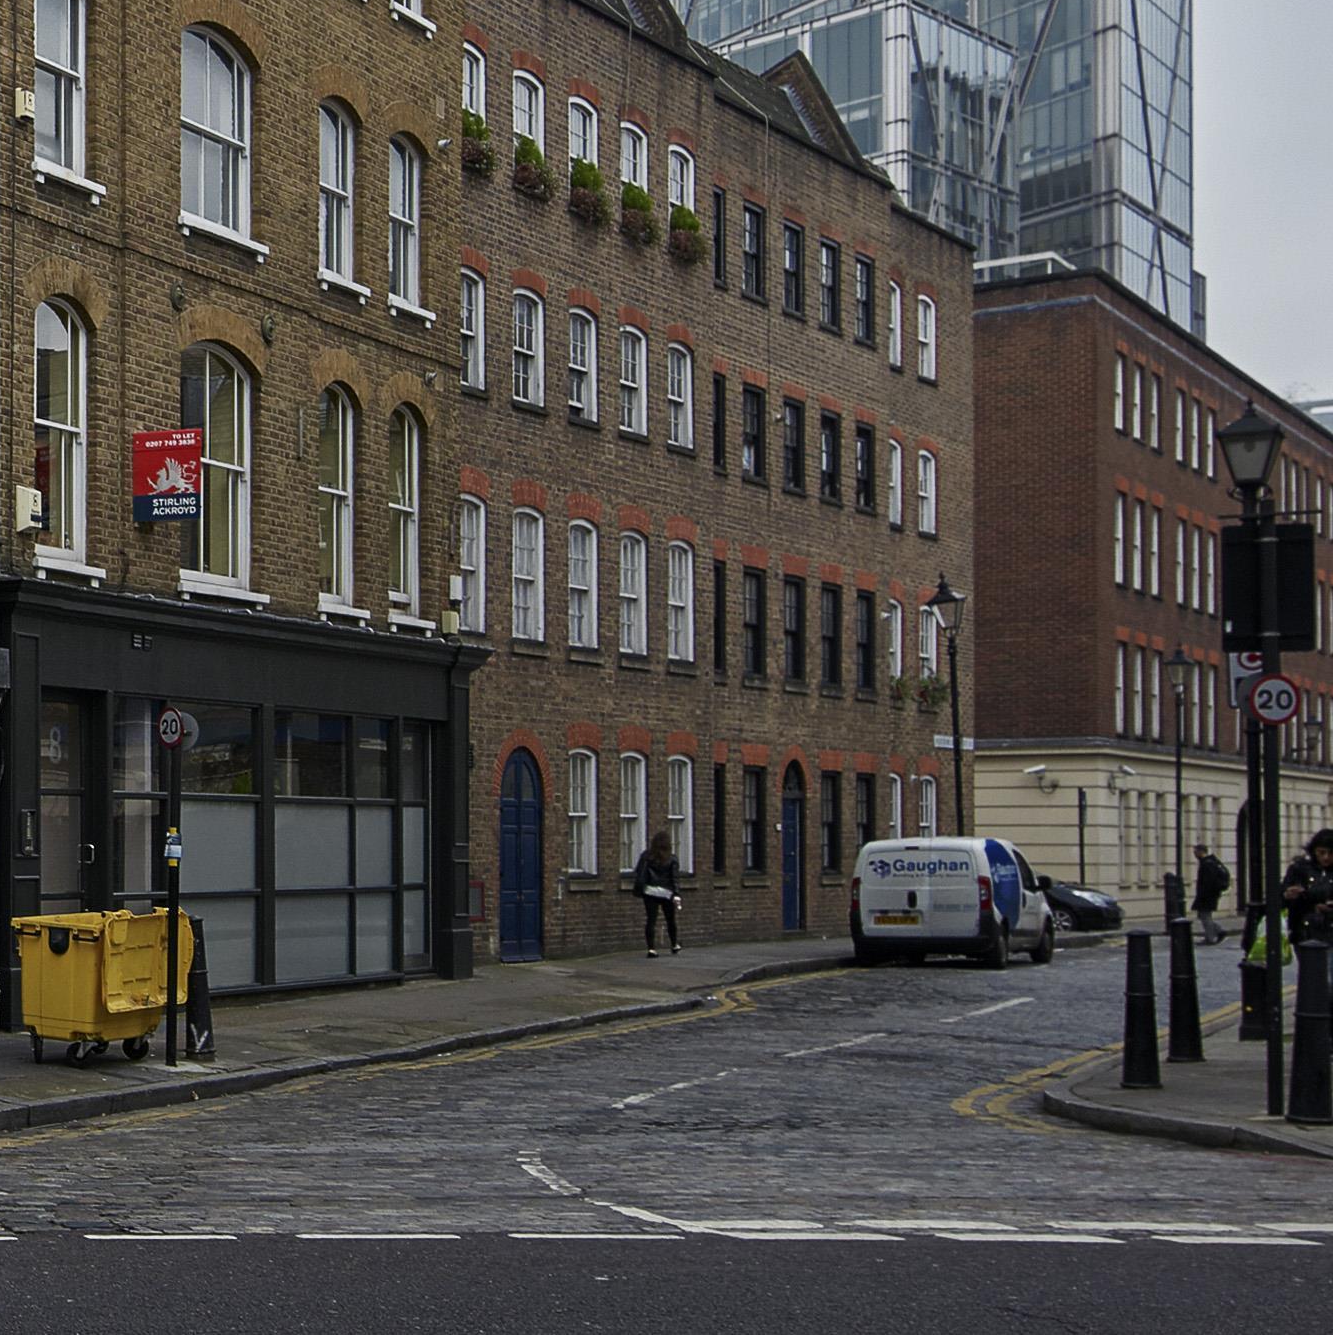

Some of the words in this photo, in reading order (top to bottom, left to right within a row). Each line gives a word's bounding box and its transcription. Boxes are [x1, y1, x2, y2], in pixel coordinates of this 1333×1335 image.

[153, 497, 196, 507] STIRLING
[153, 506, 197, 516] ACKROYD
[1256, 689, 1293, 710] 20
[161, 718, 179, 736] 20
[893, 858, 969, 875] Gaughan
